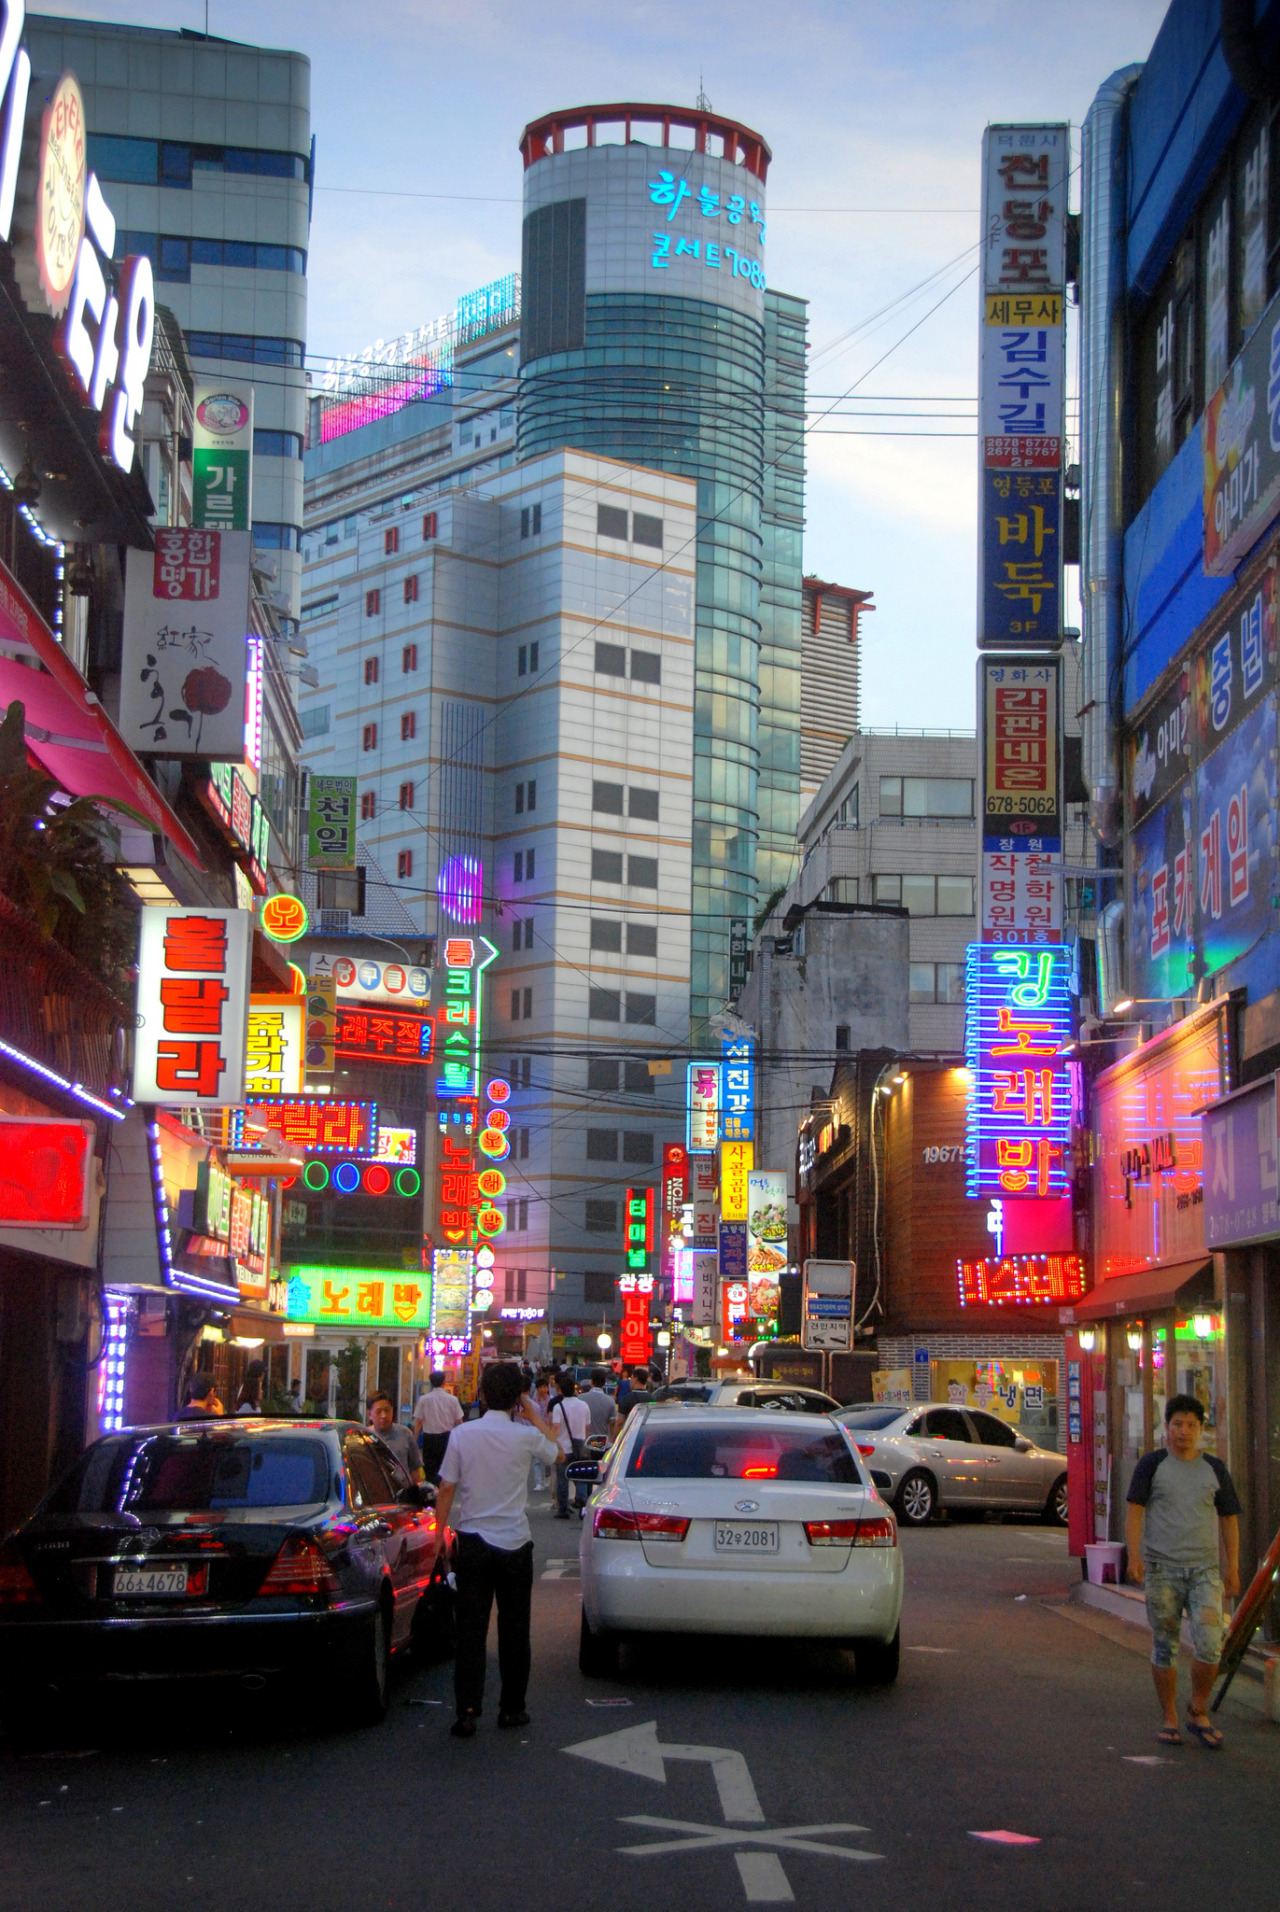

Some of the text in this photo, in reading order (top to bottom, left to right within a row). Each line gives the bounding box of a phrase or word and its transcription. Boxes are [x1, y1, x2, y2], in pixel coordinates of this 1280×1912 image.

[648, 170, 767, 245] 하늘공원
[997, 153, 1054, 285] 전당포
[989, 301, 1059, 324] 세무사
[997, 331, 1051, 434] 김수길
[987, 438, 1058, 447] 2678-6770
[987, 448, 1058, 456] 2678-6767
[1010, 456, 1034, 467] 2F
[993, 476, 1056, 497] 영등포
[993, 506, 1055, 614] 바둑
[160, 566, 217, 598] 명가
[1009, 621, 1038, 634] 3F
[989, 668, 1053, 683] 영화사
[1001, 690, 1043, 790] 간판네온
[315, 796, 350, 854] 천일
[987, 854, 1018, 928] 작명원
[992, 930, 1050, 943] 301호
[334, 960, 429, 994] 당구클럽
[335, 1015, 421, 1054] 래주점
[729, 1144, 747, 1210] 사골곰탕
[319, 1280, 423, 1322] 노래방
[701, 1272, 714, 1323] 비지니스
[625, 1298, 647, 1359] 나이트
[810, 1322, 848, 1332] 견인지역
[949, 1384, 1044, 1411] 함흥냉면
